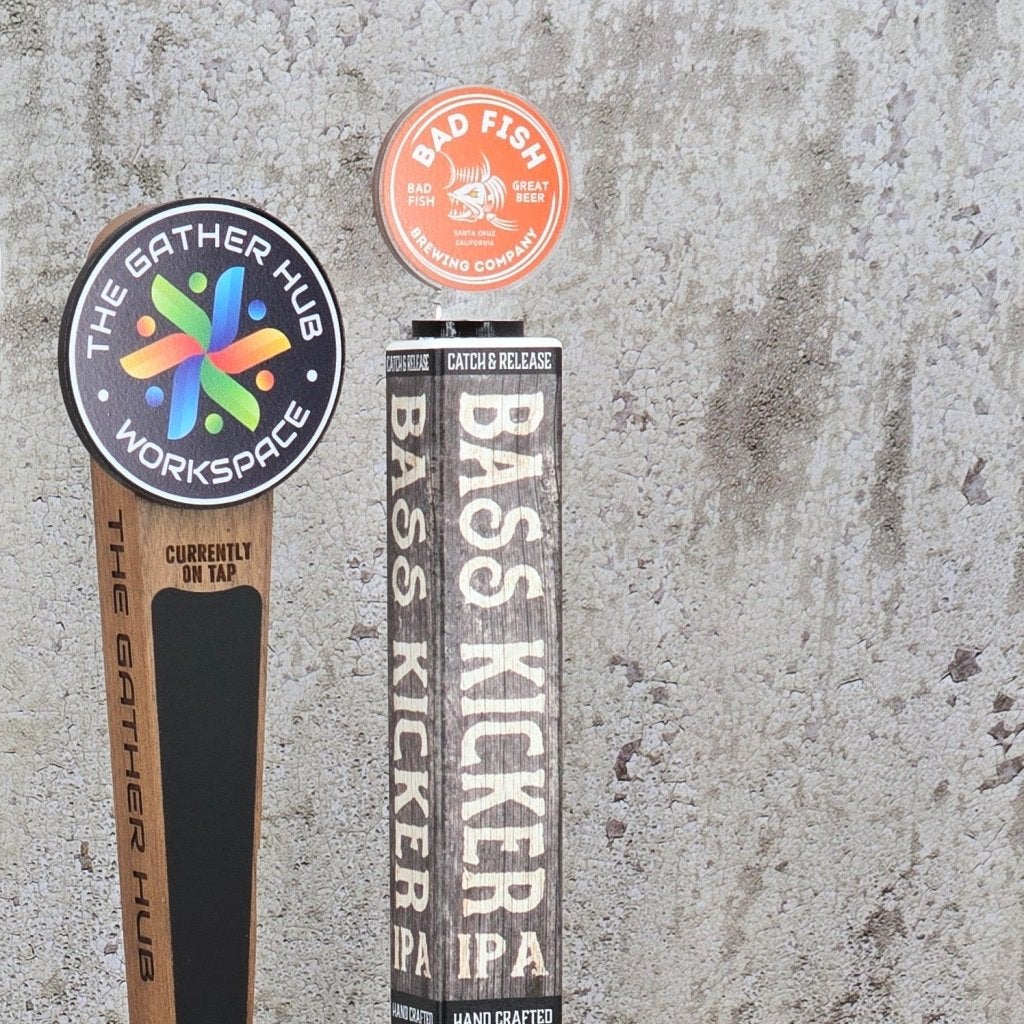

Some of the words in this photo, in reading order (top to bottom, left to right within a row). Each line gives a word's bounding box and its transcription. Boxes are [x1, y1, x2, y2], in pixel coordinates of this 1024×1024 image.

[411, 113, 469, 168] BAD
[481, 109, 547, 170] FISH
[407, 183, 432, 194] BAD
[408, 196, 435, 207] FISH
[512, 181, 549, 191] GREAT
[516, 193, 545, 203] BEER
[410, 226, 470, 272] BREWING
[474, 227, 538, 272] COMPANY
[454, 229, 476, 237] SANTA
[478, 229, 496, 237] CRUZ
[87, 278, 128, 359] THE
[124, 223, 272, 278] GATHER
[273, 259, 323, 341] HUB
[447, 352, 486, 371] CATCH
[488, 352, 496, 369] &
[499, 351, 552, 370] RELEASE
[115, 400, 311, 485] WORKSPACE
[391, 393, 427, 607] BASS
[459, 391, 544, 608] BASS
[108, 510, 129, 616] THE
[166, 542, 252, 564] CURRENTLY
[182, 566, 203, 583] ON
[209, 563, 237, 583] TAP
[116, 633, 145, 853] GATHER
[393, 640, 429, 912] KICKER
[460, 639, 545, 917] KICKER
[132, 870, 155, 983] HUB
[393, 925, 432, 979] IPA
[458, 931, 549, 979] IPA
[392, 1001, 408, 1021] HAND
